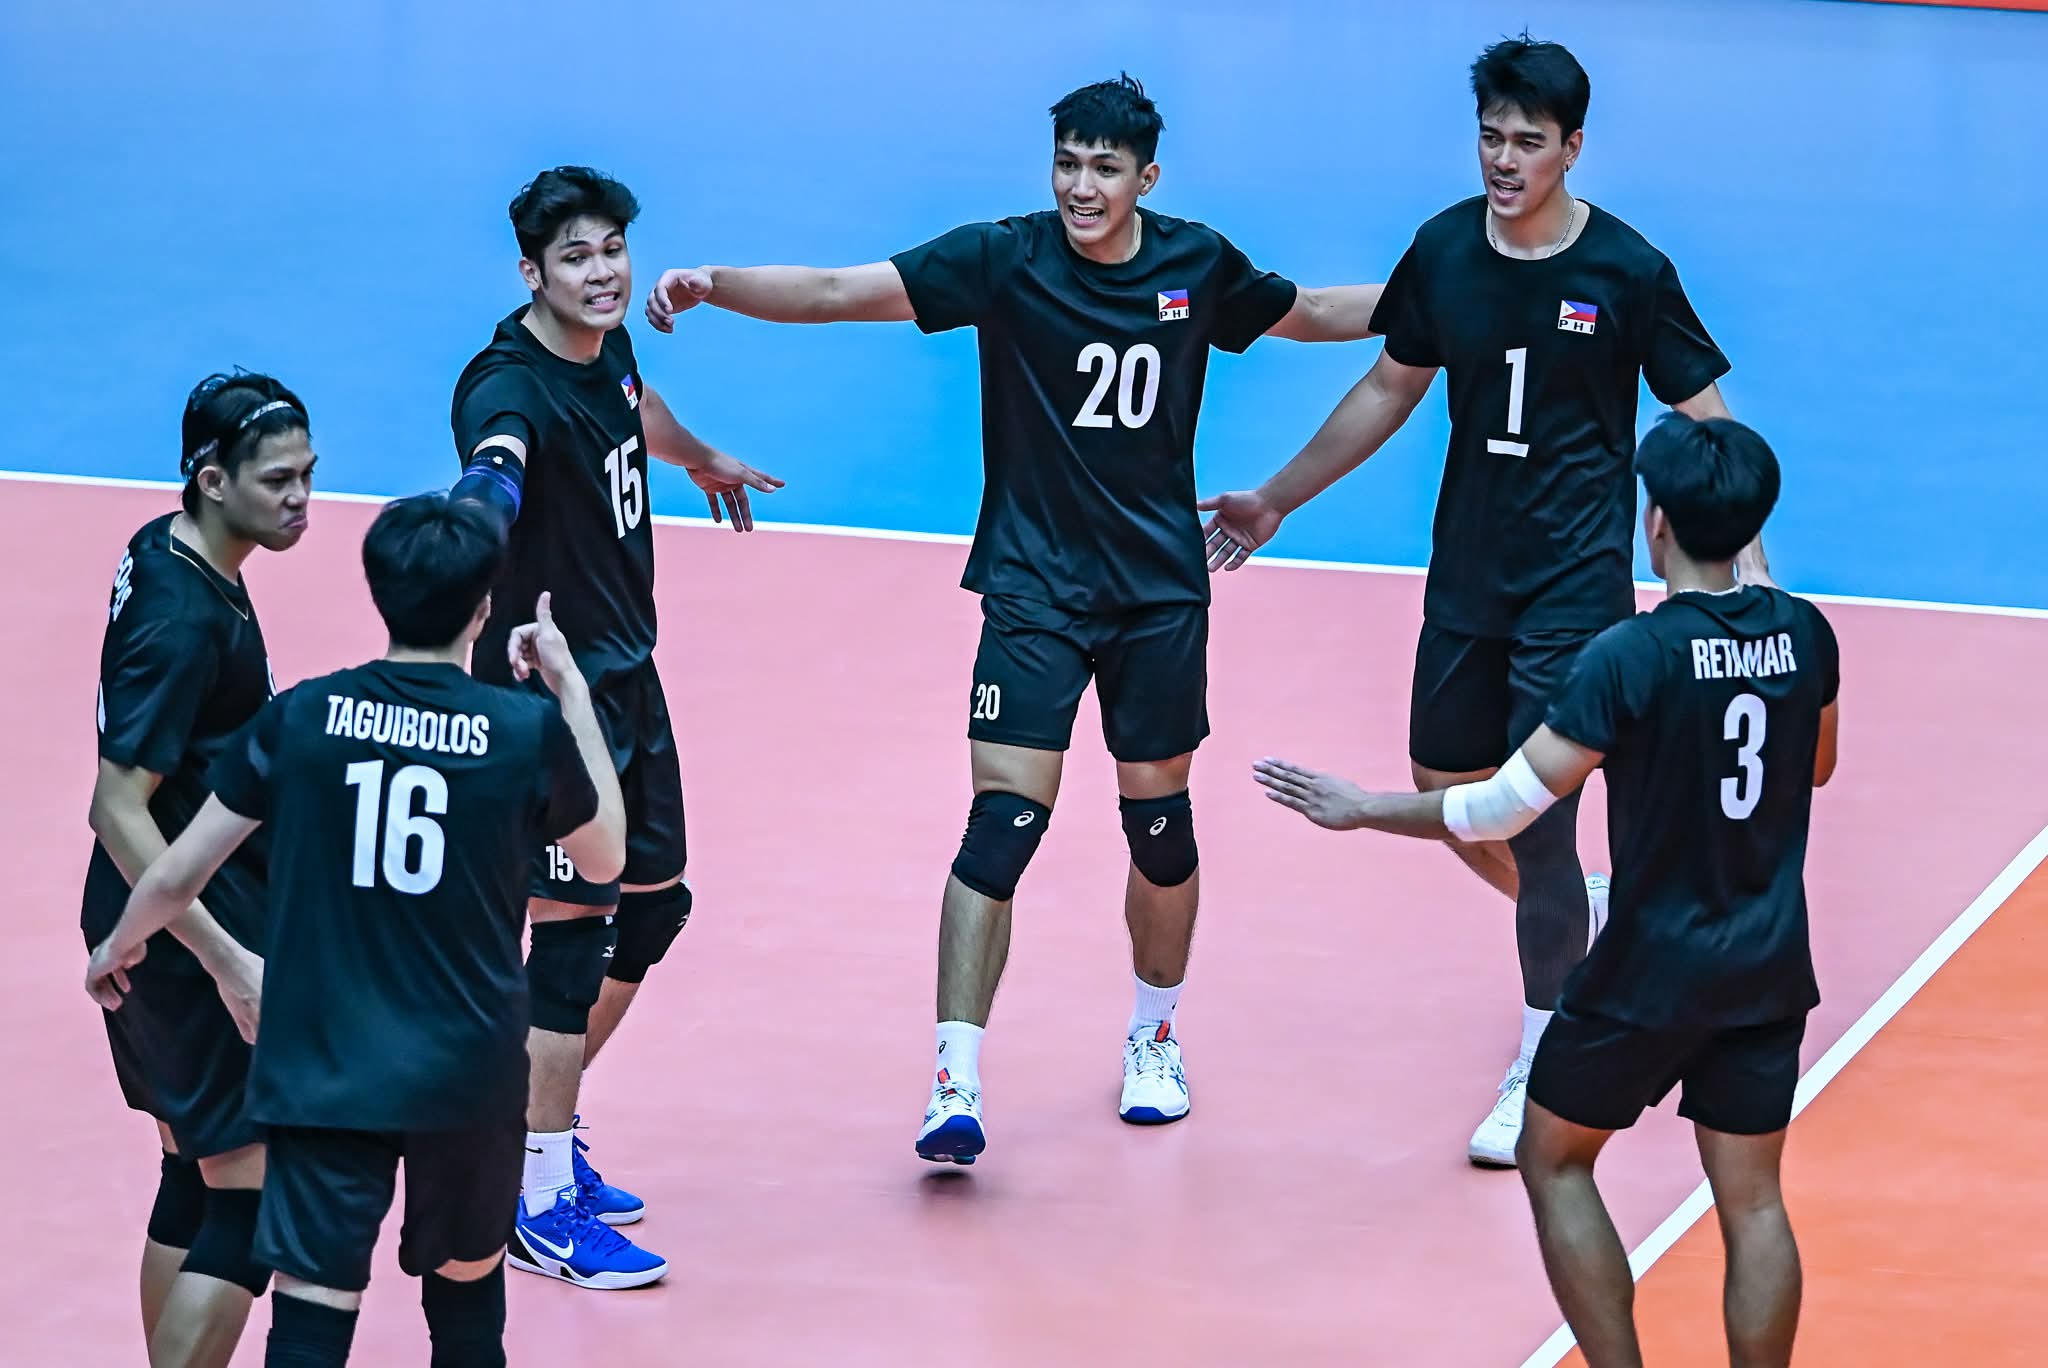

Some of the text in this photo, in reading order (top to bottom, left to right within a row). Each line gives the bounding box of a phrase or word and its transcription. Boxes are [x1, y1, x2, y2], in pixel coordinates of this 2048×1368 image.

[1160, 308, 1189, 320] PHI
[1559, 319, 1594, 333] PHI
[1072, 342, 1161, 429] 20
[1505, 347, 1527, 435] 1
[604, 434, 643, 540] 15
[1691, 632, 1798, 680] RETAMAR
[325, 694, 490, 756] TAGUIBOLOS
[972, 683, 1001, 720] 20
[1720, 693, 1767, 820] 3
[345, 759, 449, 895] 16
[545, 845, 574, 882] 15
